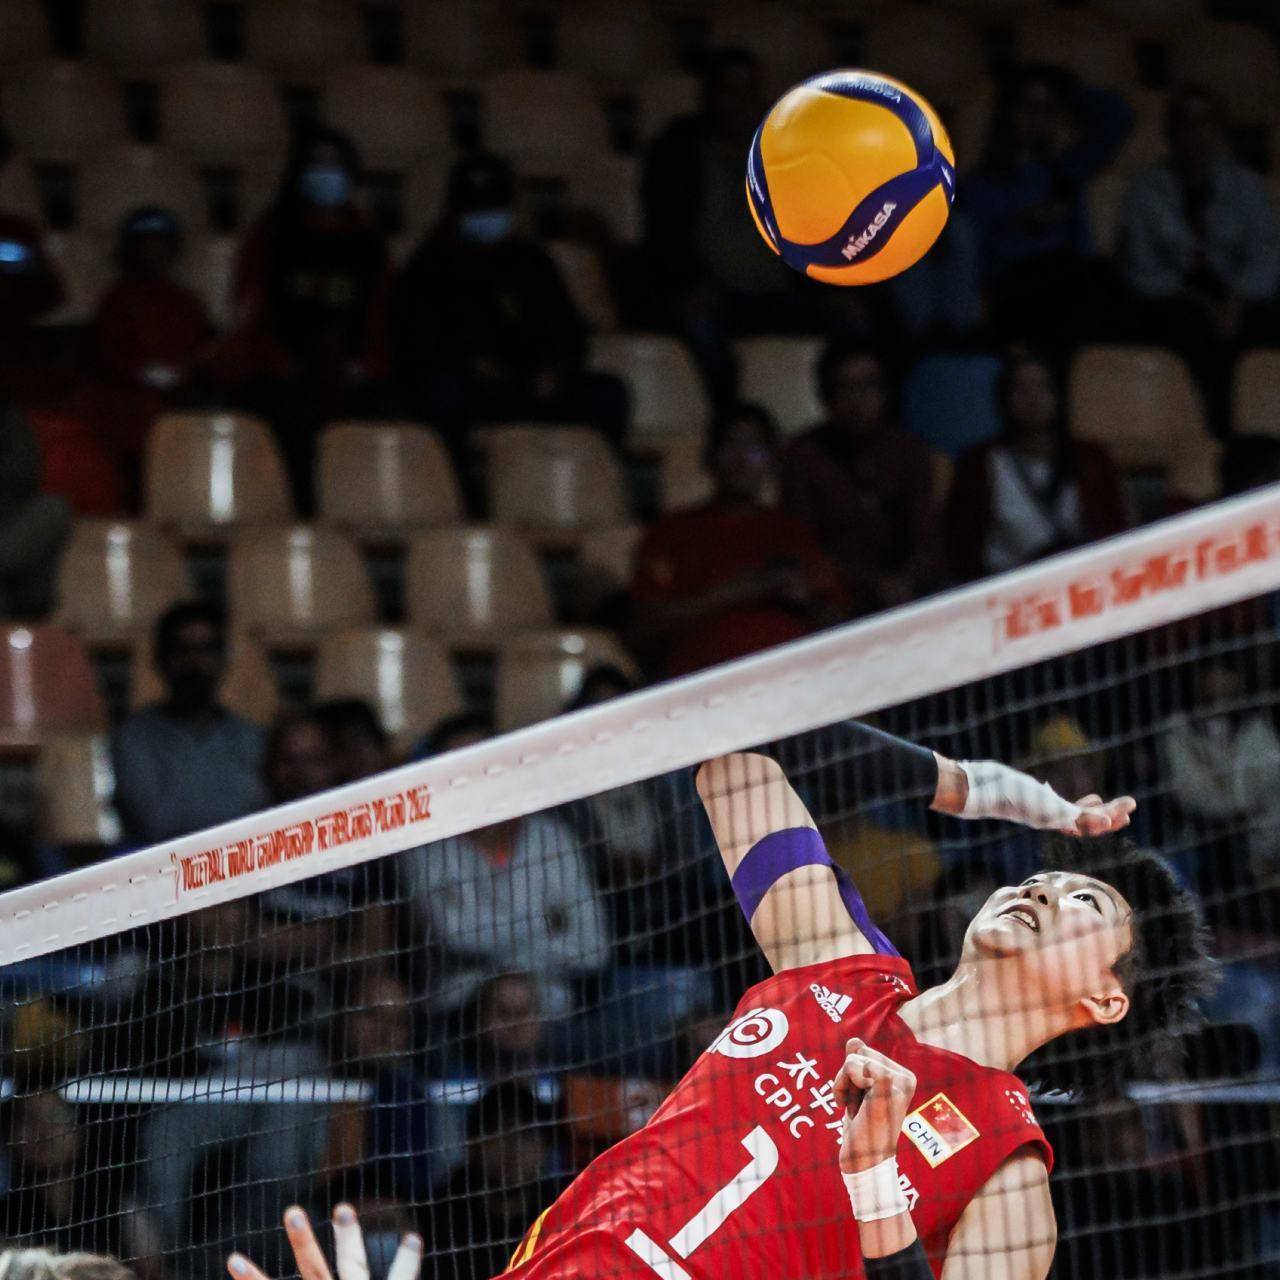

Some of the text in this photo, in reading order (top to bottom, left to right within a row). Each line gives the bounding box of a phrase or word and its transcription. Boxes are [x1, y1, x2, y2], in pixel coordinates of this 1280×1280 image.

[841, 201, 897, 260] MIKASA
[180, 847, 226, 892] VOLLEYBALL
[810, 983, 842, 1023] adidas
[754, 1073, 815, 1139] CPIC
[908, 1121, 943, 1158] CHN
